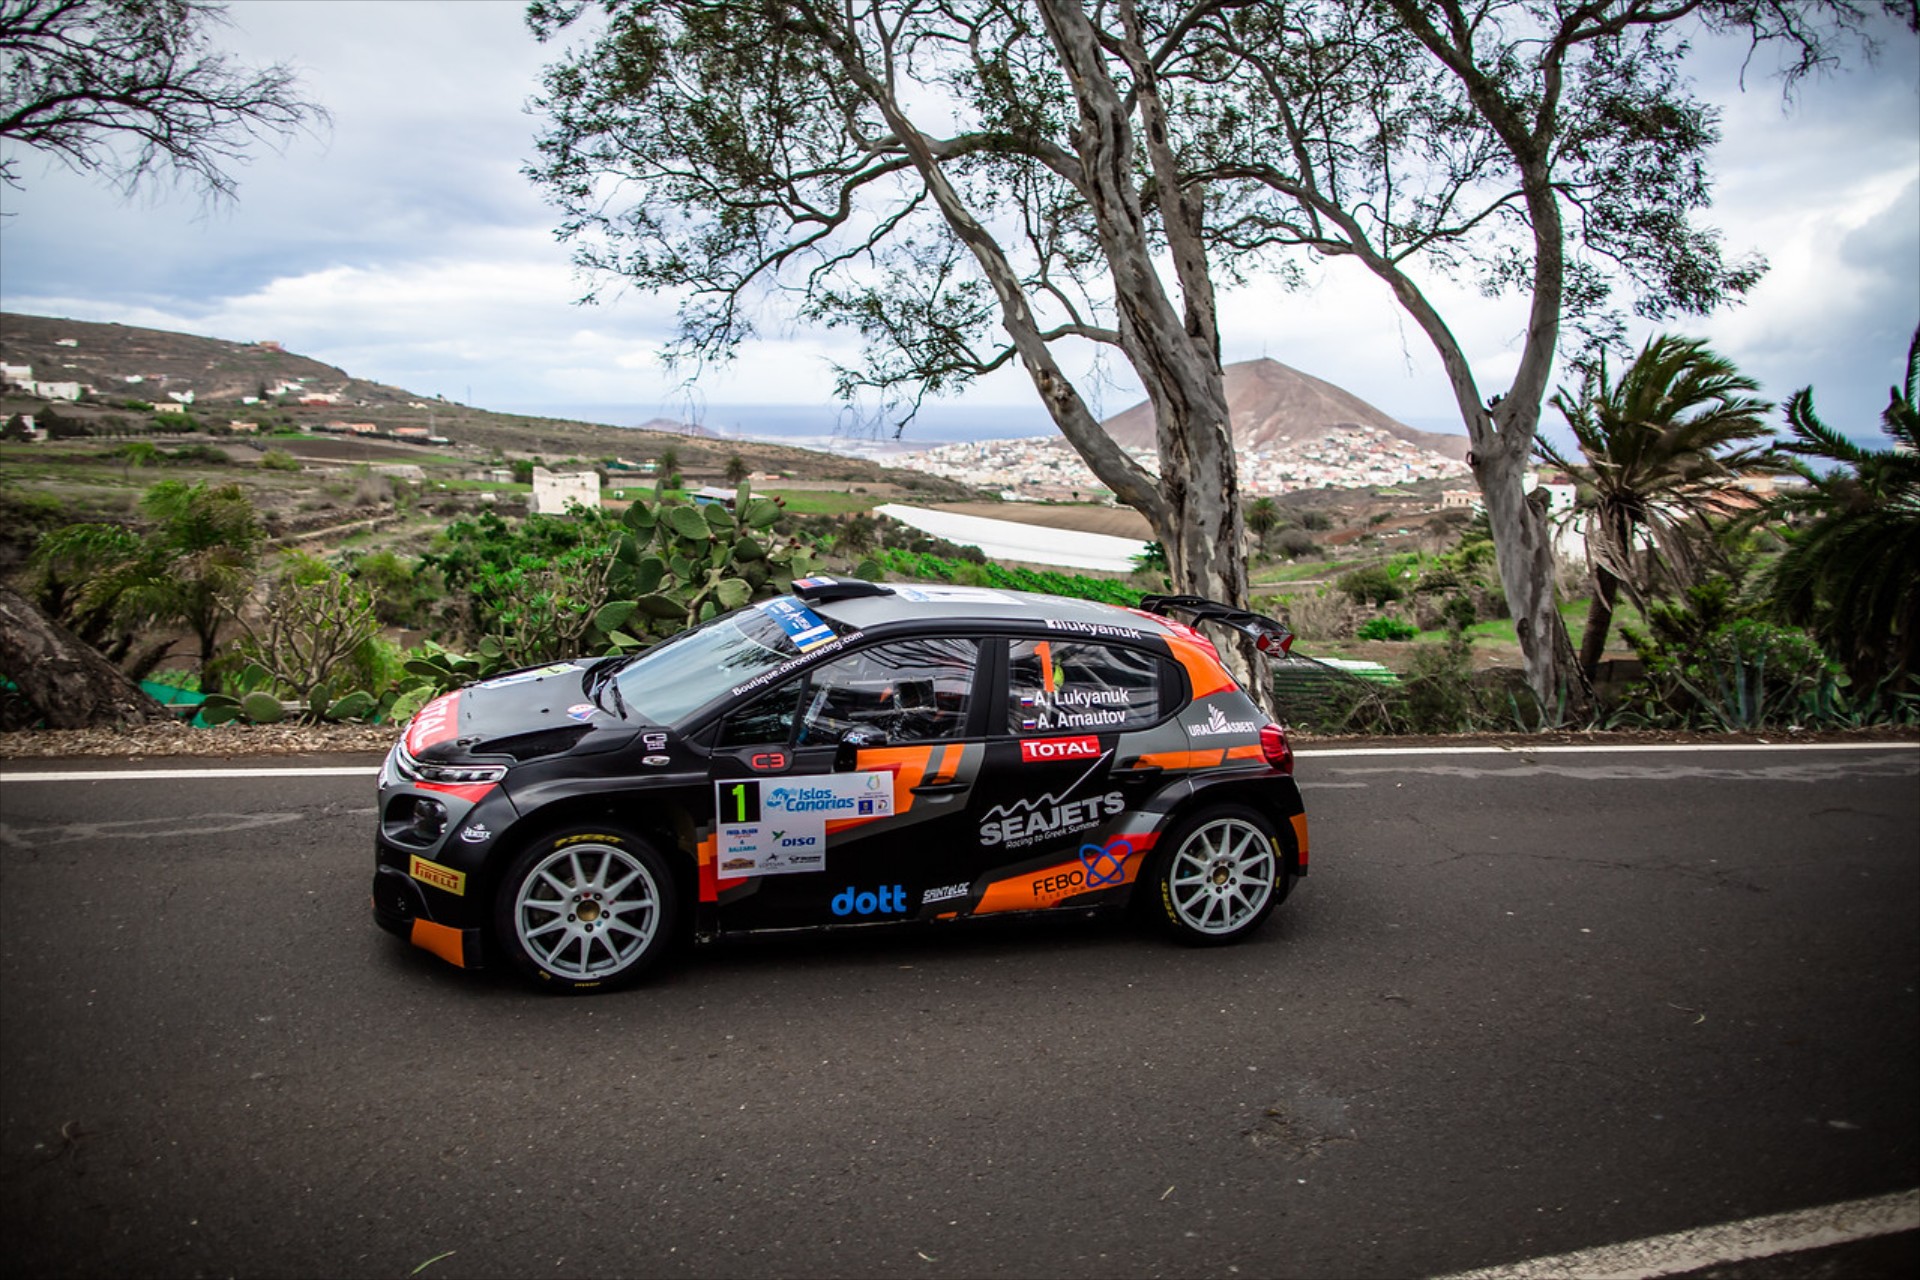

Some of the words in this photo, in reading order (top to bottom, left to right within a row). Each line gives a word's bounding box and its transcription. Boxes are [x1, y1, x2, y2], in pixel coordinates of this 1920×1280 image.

[732, 631, 864, 696] Boutique.citroenracing.com
[1034, 641, 1055, 693] 1
[1034, 692, 1051, 706] A.
[1054, 688, 1130, 708] Lukyanuk
[1037, 713, 1054, 729] A.
[1057, 710, 1126, 729] Arnautov
[752, 753, 785, 769] C3
[1023, 741, 1096, 757] TOTAL
[732, 784, 746, 822] 1
[786, 795, 855, 812] Canarias
[799, 788, 832, 800] Islas
[979, 791, 1126, 846] SEAJETS
[1006, 836, 1034, 849] Racing
[1034, 834, 1043, 843] to
[415, 861, 460, 890] PIRELLI
[1032, 869, 1084, 897] FEBO
[831, 885, 907, 916] dott
